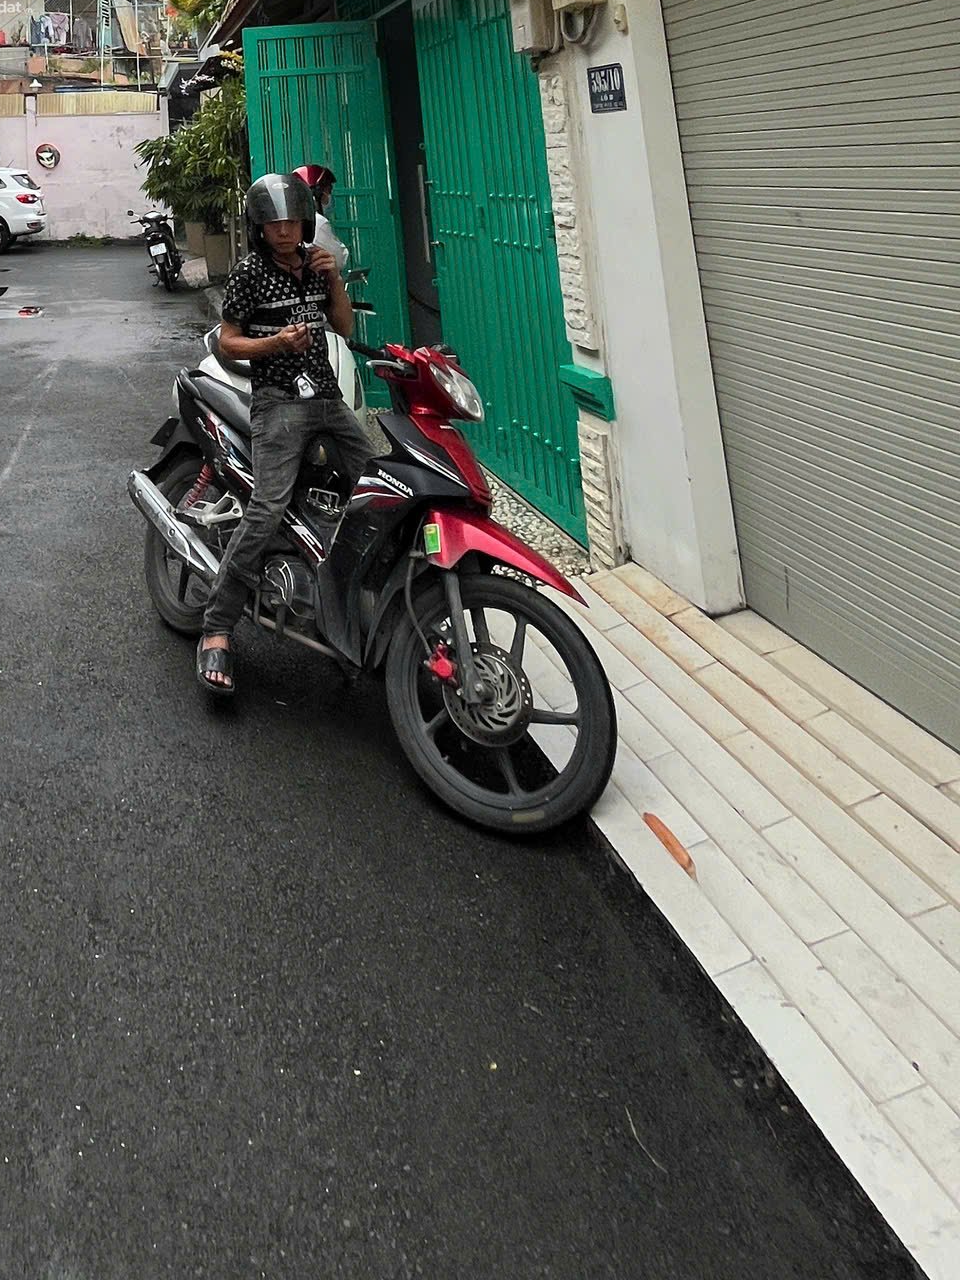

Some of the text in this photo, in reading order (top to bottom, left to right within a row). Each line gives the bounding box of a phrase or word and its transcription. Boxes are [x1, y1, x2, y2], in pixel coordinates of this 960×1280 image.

[591, 68, 620, 93] 595/10
[286, 311, 323, 325] VUITTON
[291, 302, 318, 315] LOUIS
[377, 468, 414, 497] HONDA
